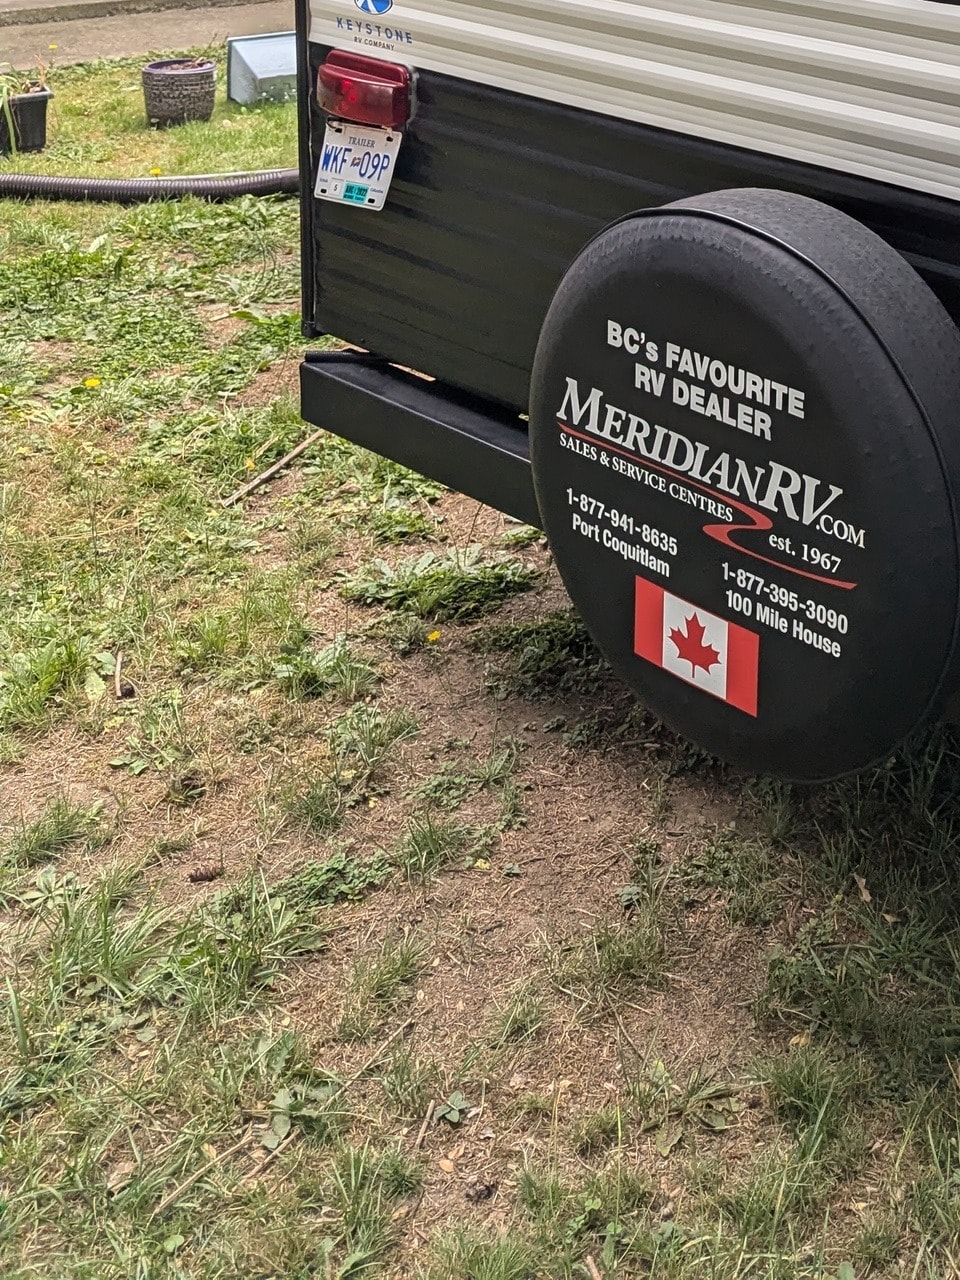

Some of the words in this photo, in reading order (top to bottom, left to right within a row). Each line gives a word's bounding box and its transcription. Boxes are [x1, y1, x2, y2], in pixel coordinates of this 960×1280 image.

[336, 17, 412, 44] KEYSTONE
[364, 39, 395, 51] COMPANY
[348, 136, 376, 148] TRAILER
[607, 320, 658, 363] BC's
[666, 342, 805, 419] FAVOURITE
[635, 363, 665, 397] RV
[673, 381, 772, 441] DEALER
[559, 432, 597, 460] SALES
[600, 451, 610, 468] &
[612, 457, 667, 493] SERVICE
[669, 482, 733, 522] CENTRES
[566, 488, 678, 556] 1-877-941-8635
[572, 513, 599, 542] Port
[603, 529, 670, 577] Coquitlam
[769, 534, 796, 556] est.
[801, 544, 841, 573] 1967
[722, 562, 848, 634] 1-877-395-3090
[726, 589, 752, 616] 100
[756, 603, 788, 633] Mile
[793, 619, 841, 657] House
